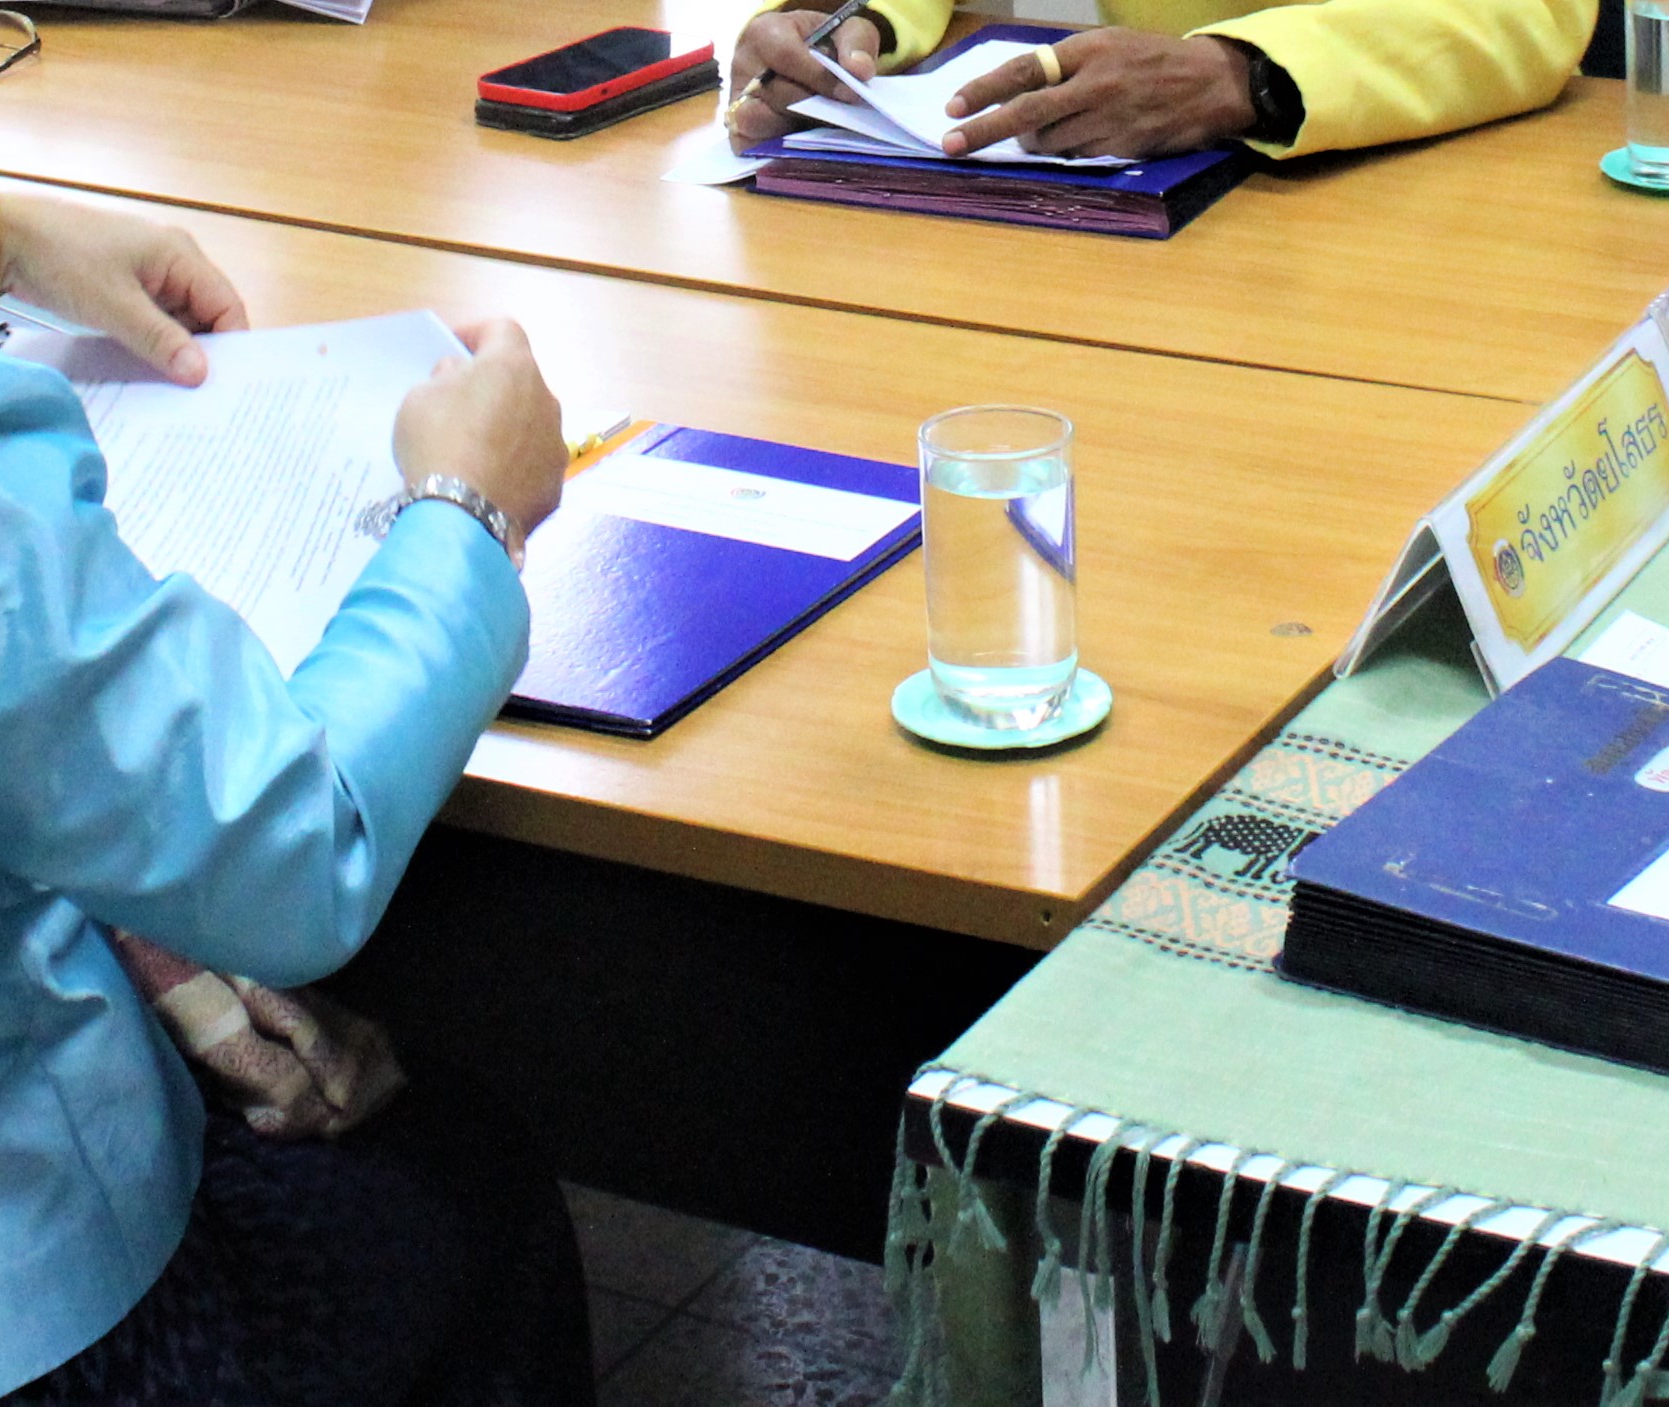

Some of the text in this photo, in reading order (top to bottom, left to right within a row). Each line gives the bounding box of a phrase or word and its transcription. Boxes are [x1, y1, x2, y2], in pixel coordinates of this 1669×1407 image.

[1517, 403, 1668, 562] จังหวัดยโสธร
